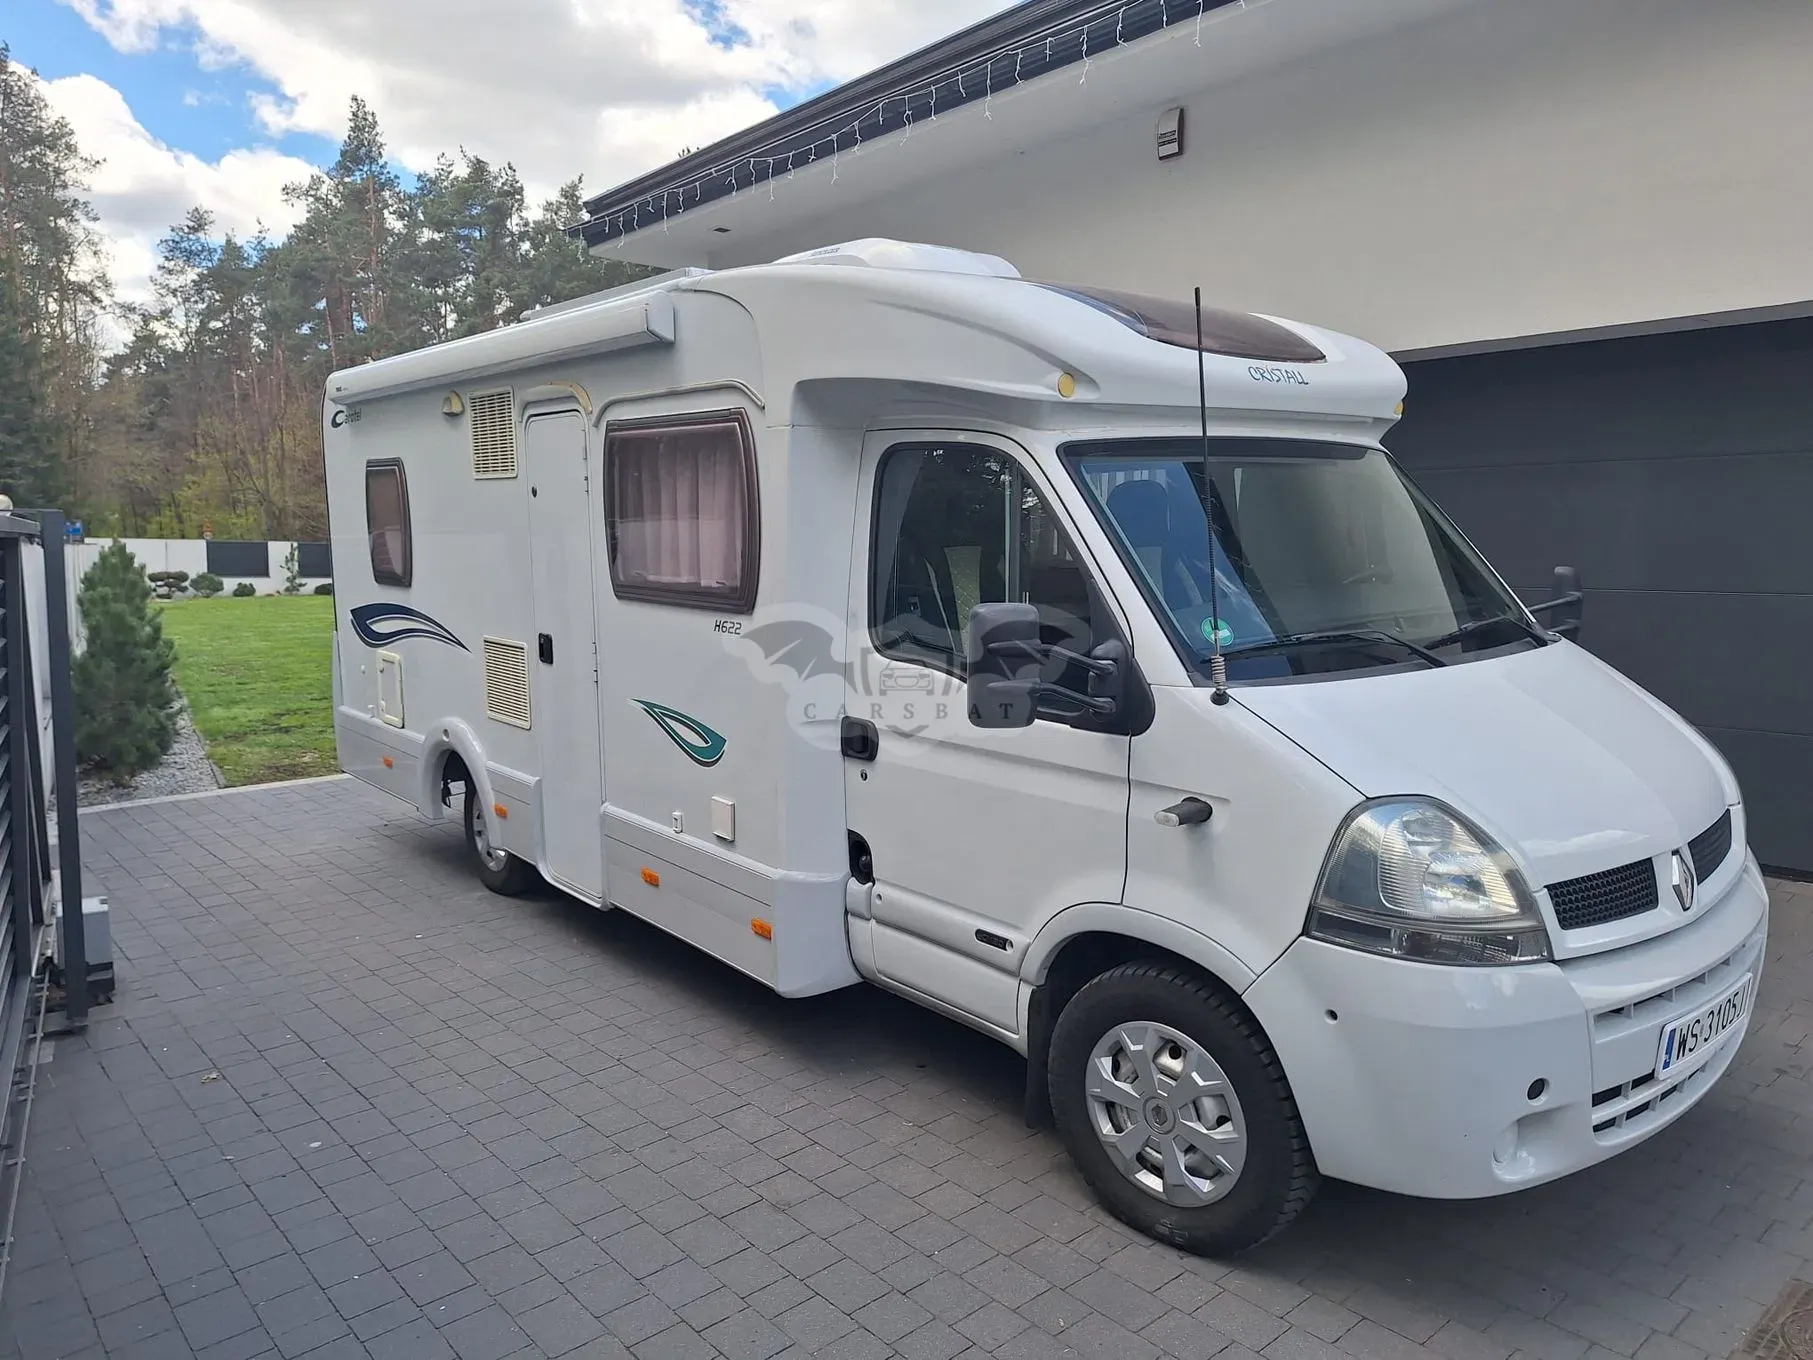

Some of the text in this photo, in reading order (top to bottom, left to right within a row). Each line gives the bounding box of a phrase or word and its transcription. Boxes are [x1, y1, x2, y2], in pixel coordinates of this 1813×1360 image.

[1248, 366, 1309, 385] CRISTALL
[714, 619, 742, 635] H622
[1676, 1018, 1701, 1061] WS
